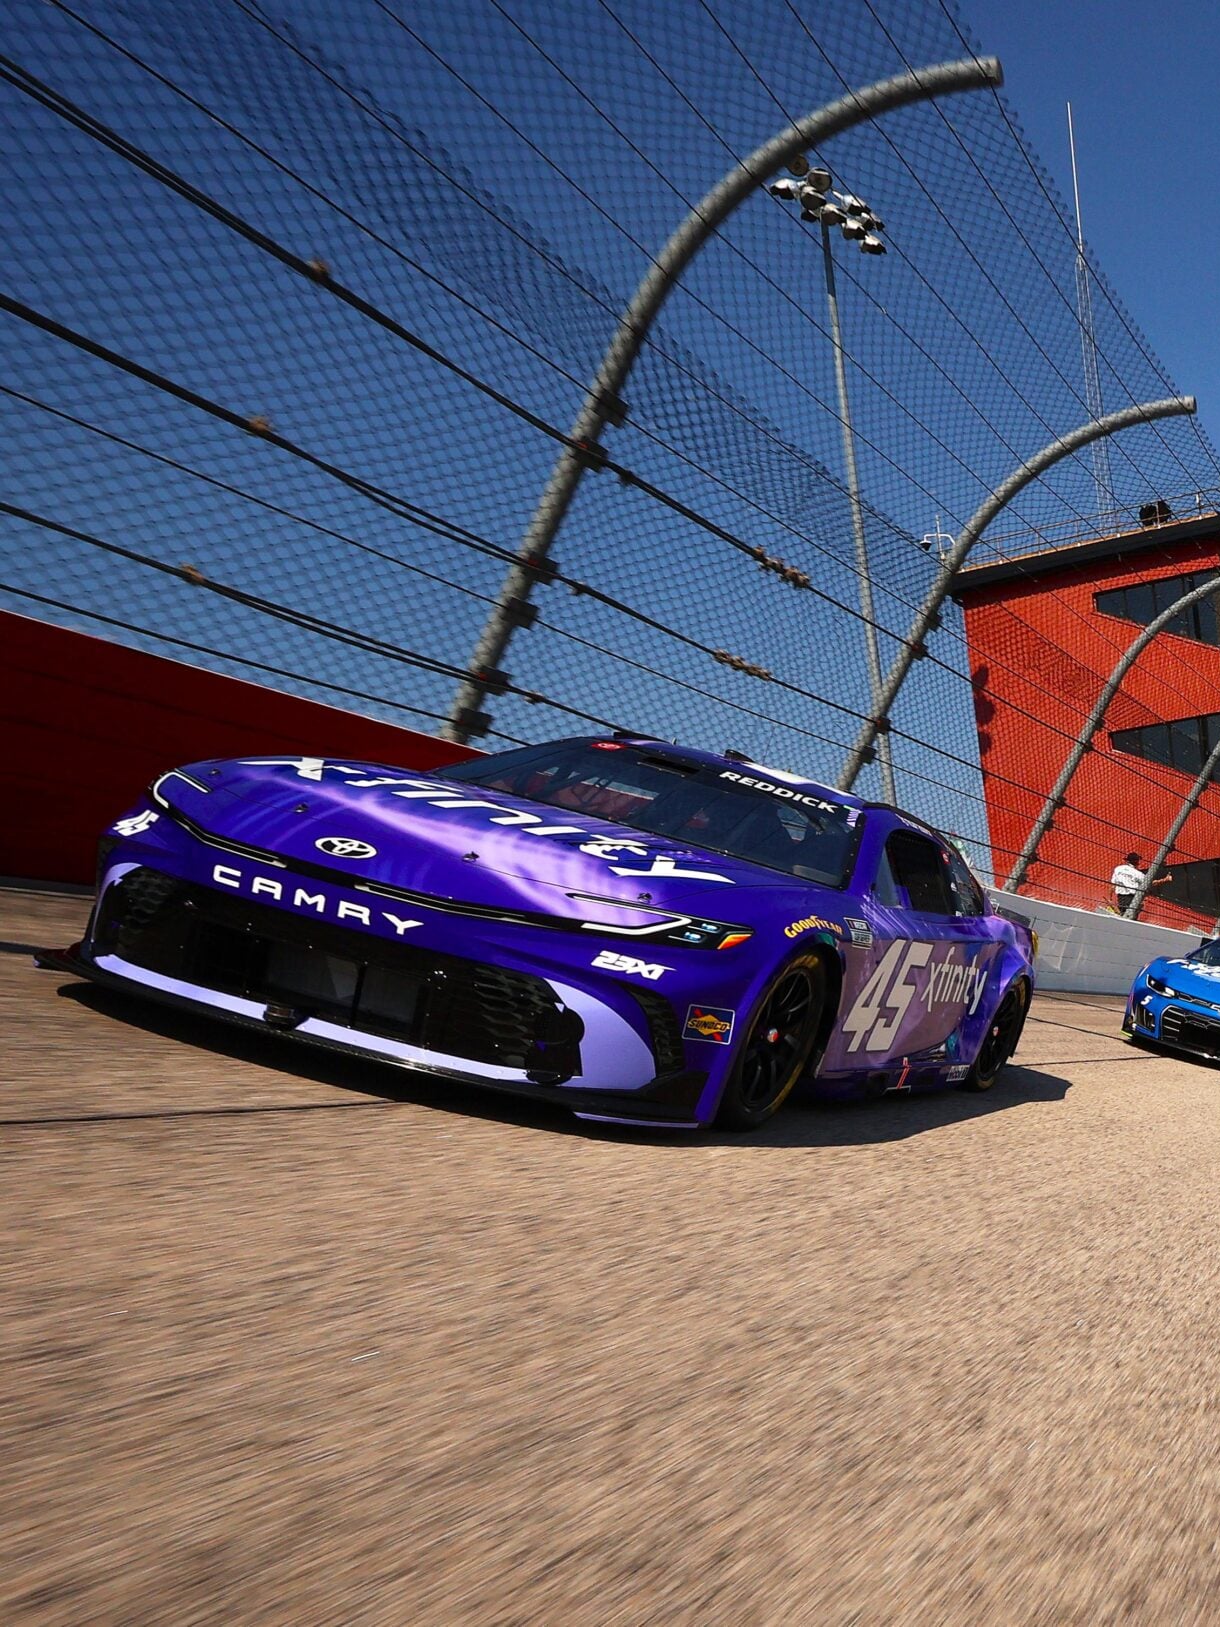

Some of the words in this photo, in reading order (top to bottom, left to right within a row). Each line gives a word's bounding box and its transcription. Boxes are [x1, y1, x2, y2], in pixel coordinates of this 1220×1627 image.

[719, 771, 839, 814] REDDICK
[112, 809, 160, 836] 45
[238, 757, 736, 884] xfinity
[213, 864, 425, 935] CAMRY
[784, 914, 843, 938] GOODYEAR
[842, 938, 934, 1053] 45
[921, 946, 987, 1015] xfinity
[1140, 995, 1153, 1005] 5
[689, 1018, 729, 1032] SUNOCO
